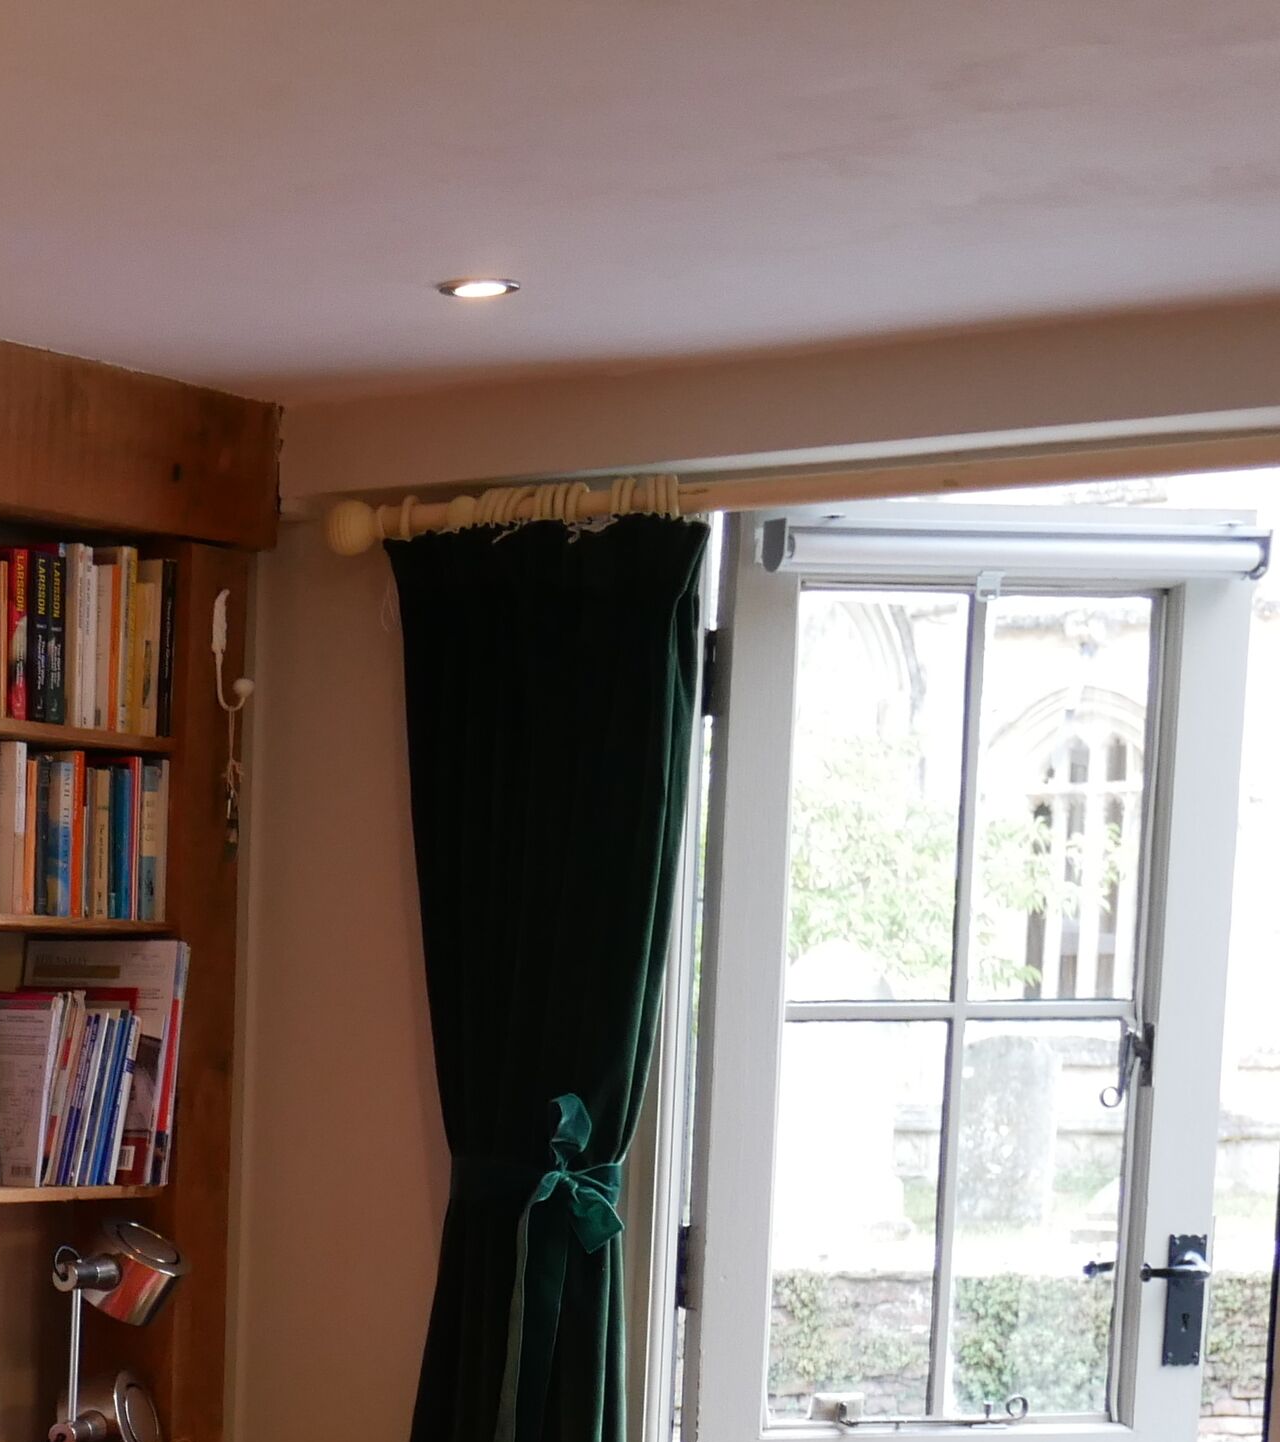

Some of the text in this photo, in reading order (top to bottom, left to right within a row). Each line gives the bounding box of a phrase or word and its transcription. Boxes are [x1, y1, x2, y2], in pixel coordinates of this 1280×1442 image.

[15, 556, 25, 612] LARSSON
[37, 558, 46, 615] LARSSON
[52, 562, 61, 618] LARSSON
